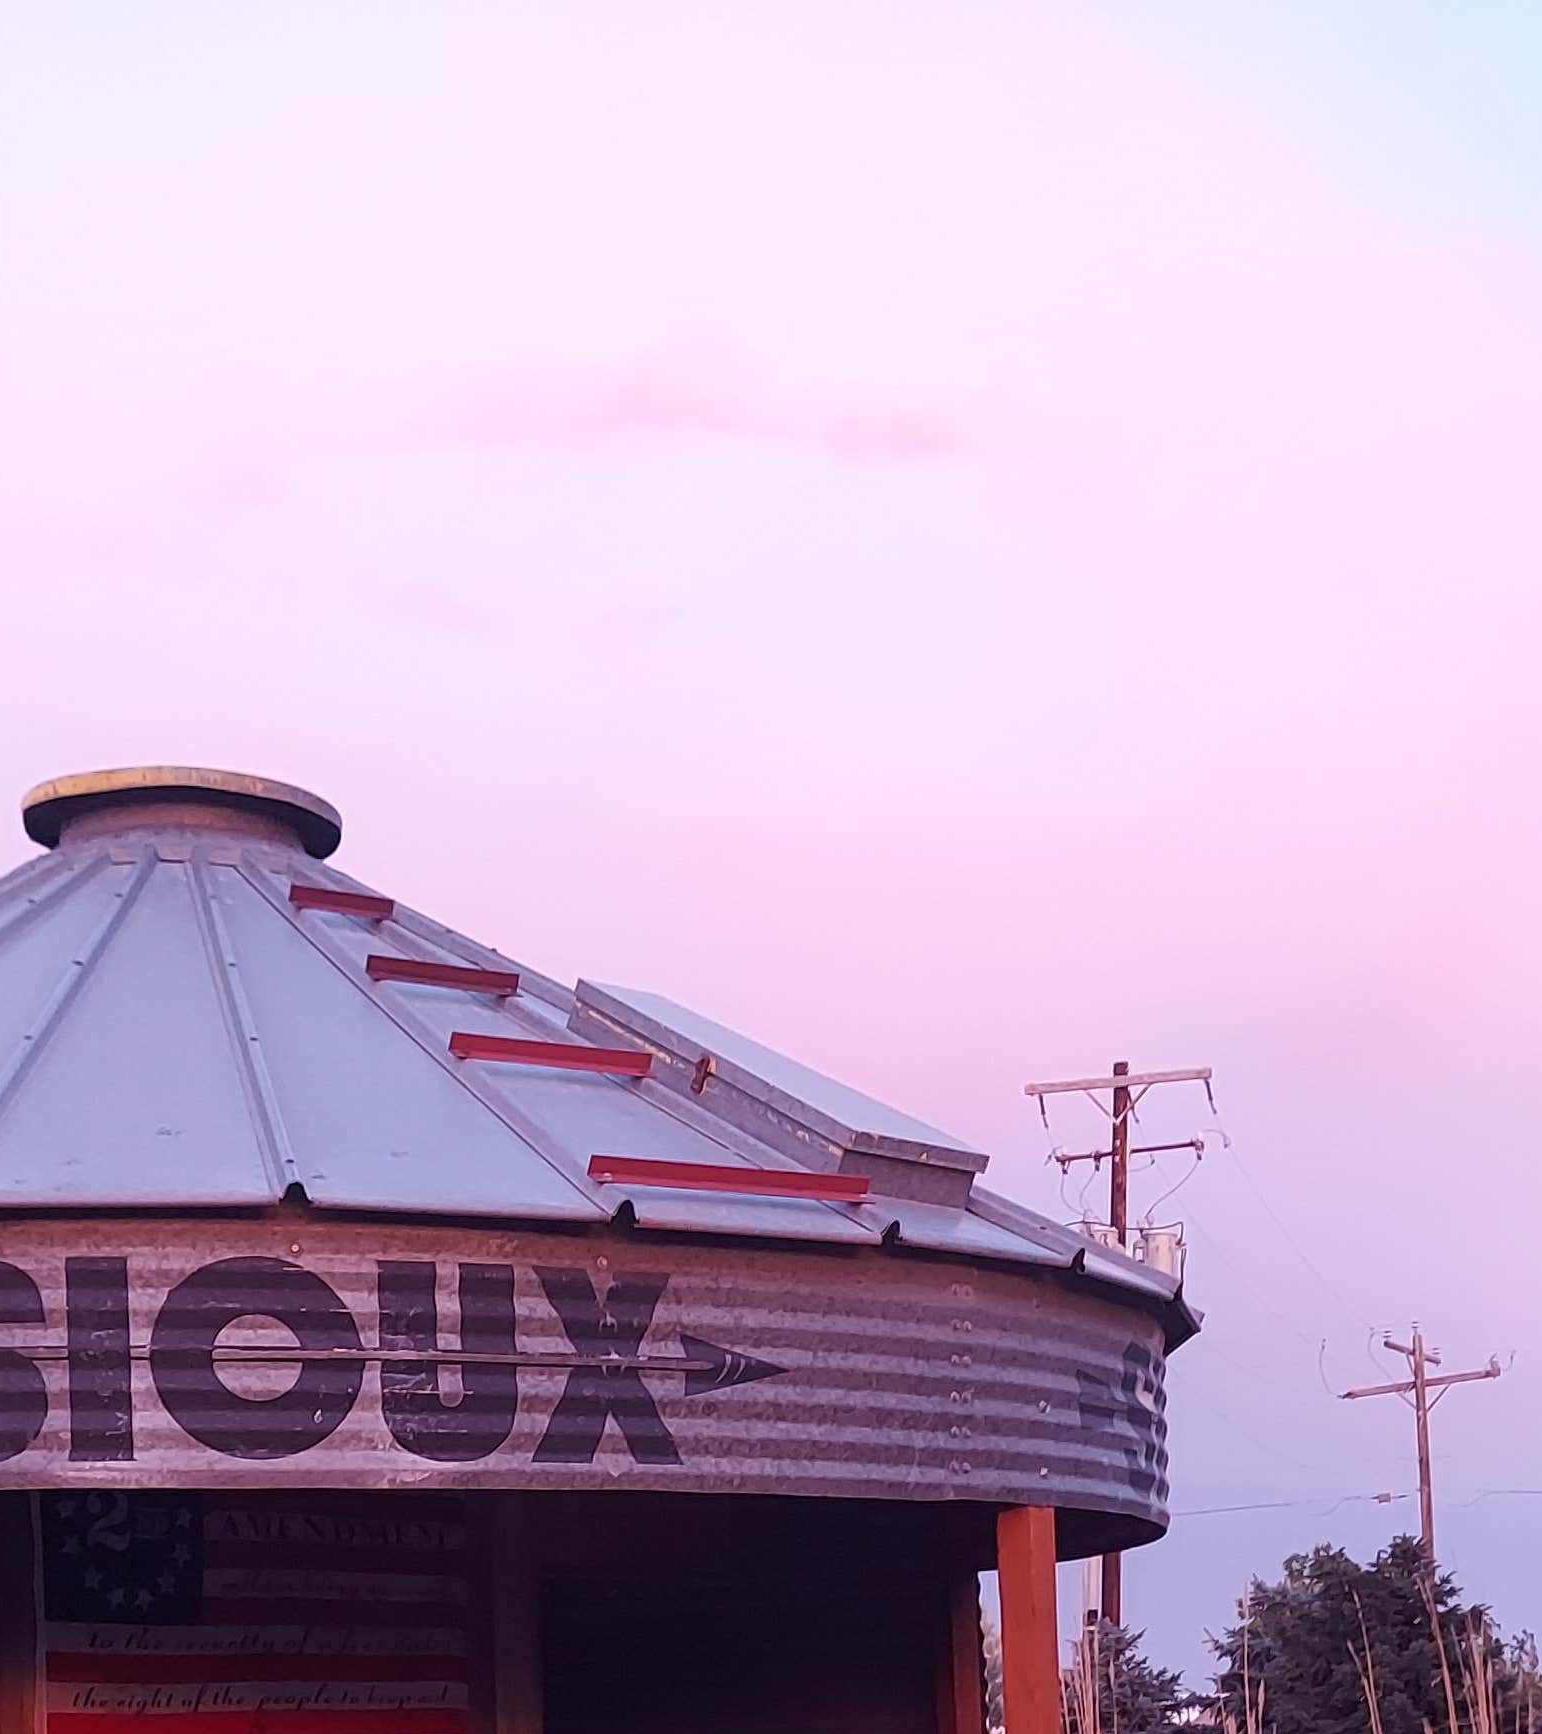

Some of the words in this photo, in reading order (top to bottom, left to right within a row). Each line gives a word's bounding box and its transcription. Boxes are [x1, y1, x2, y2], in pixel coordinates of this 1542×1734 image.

[72, 1686, 109, 1707] the
[180, 1684, 205, 1712] of
[211, 1686, 246, 1706] the
[255, 1682, 332, 1711] people
[341, 1690, 363, 1704] to
